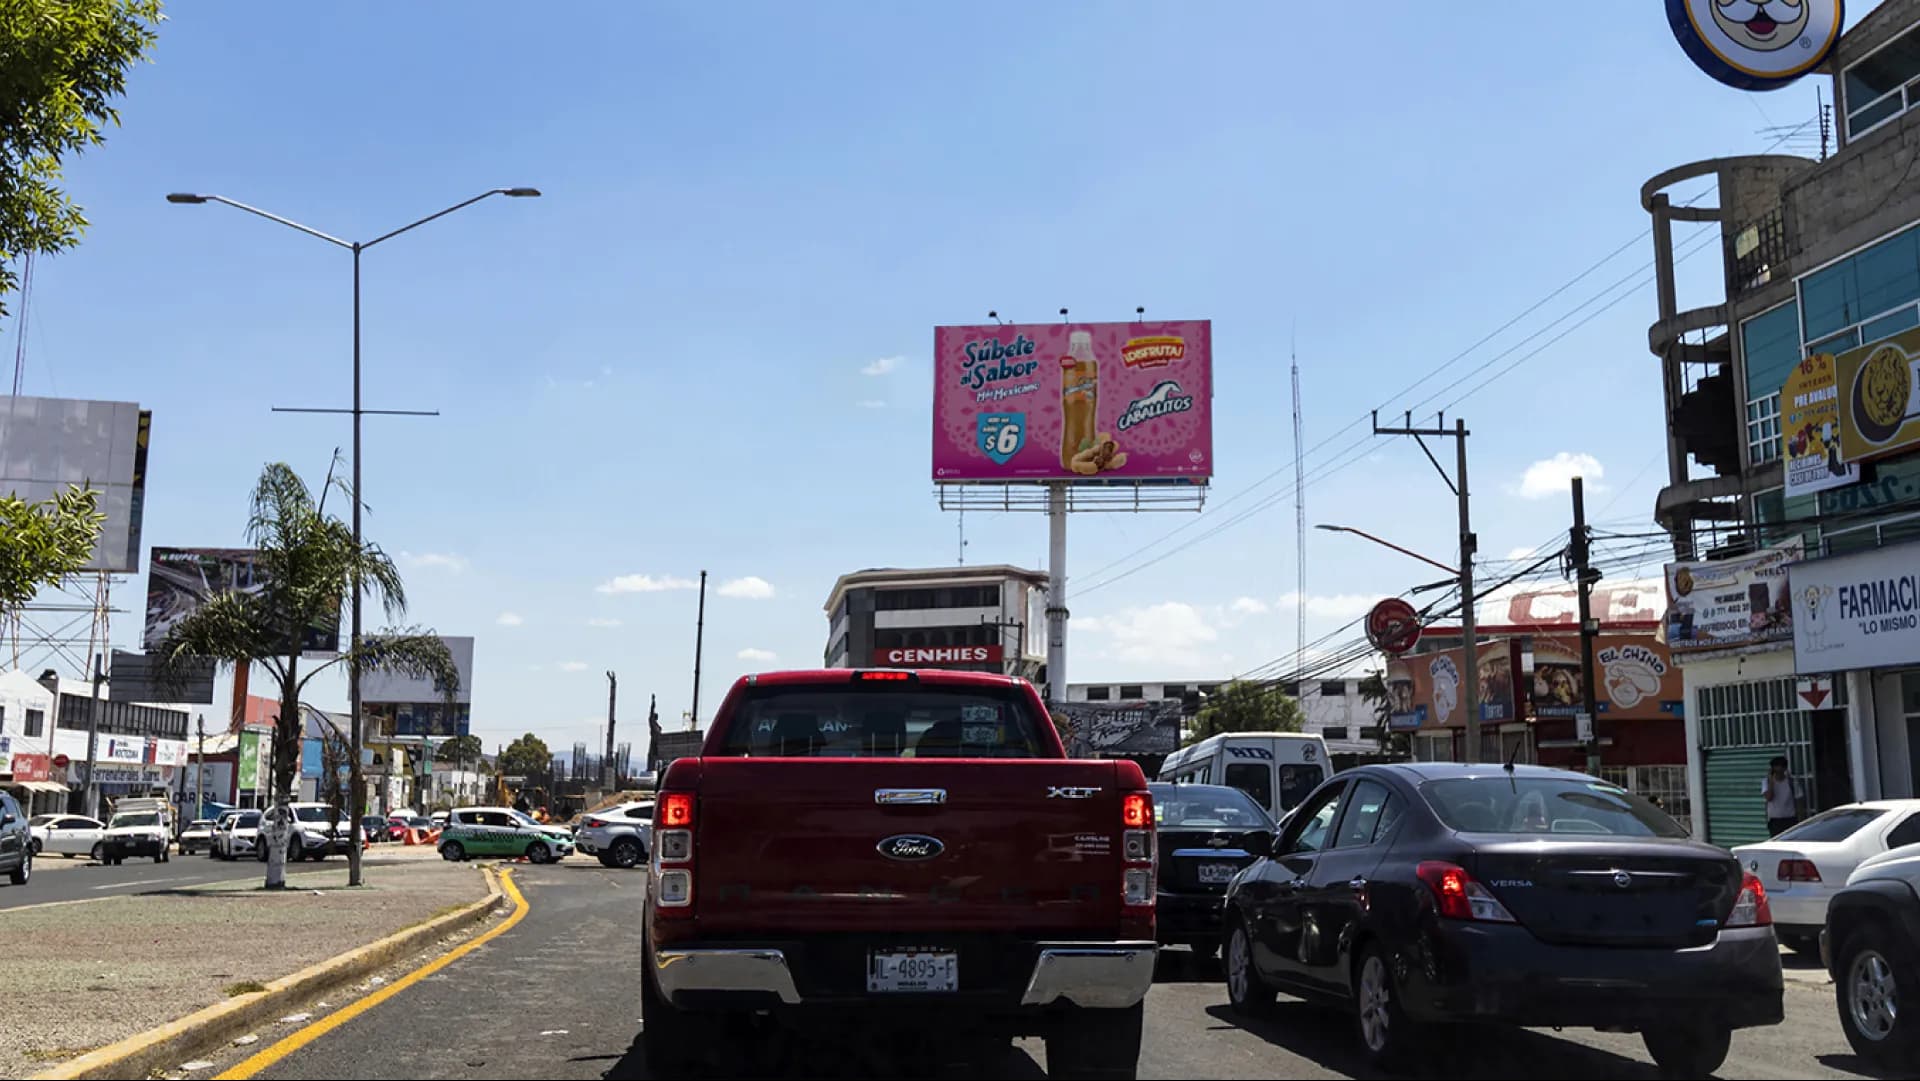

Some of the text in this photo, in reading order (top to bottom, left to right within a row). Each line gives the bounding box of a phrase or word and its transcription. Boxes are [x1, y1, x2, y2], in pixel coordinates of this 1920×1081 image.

[963, 335, 1034, 367] Súbete
[960, 369, 971, 385] al
[971, 358, 1037, 389] Sabor
[1799, 360, 1813, 375] 16
[1119, 398, 1191, 428] CABALLITOS
[985, 424, 1019, 454] $6
[1839, 576, 1920, 619] FARMACI
[1880, 614, 1917, 632] MISMO
[888, 648, 988, 662] CENHIES
[1600, 648, 1664, 673] EL CHINO
[173, 791, 217, 804] CARSA
[1047, 786, 1102, 799] XLT
[892, 838, 930, 856] Ford
[1490, 879, 1533, 888] VERSA
